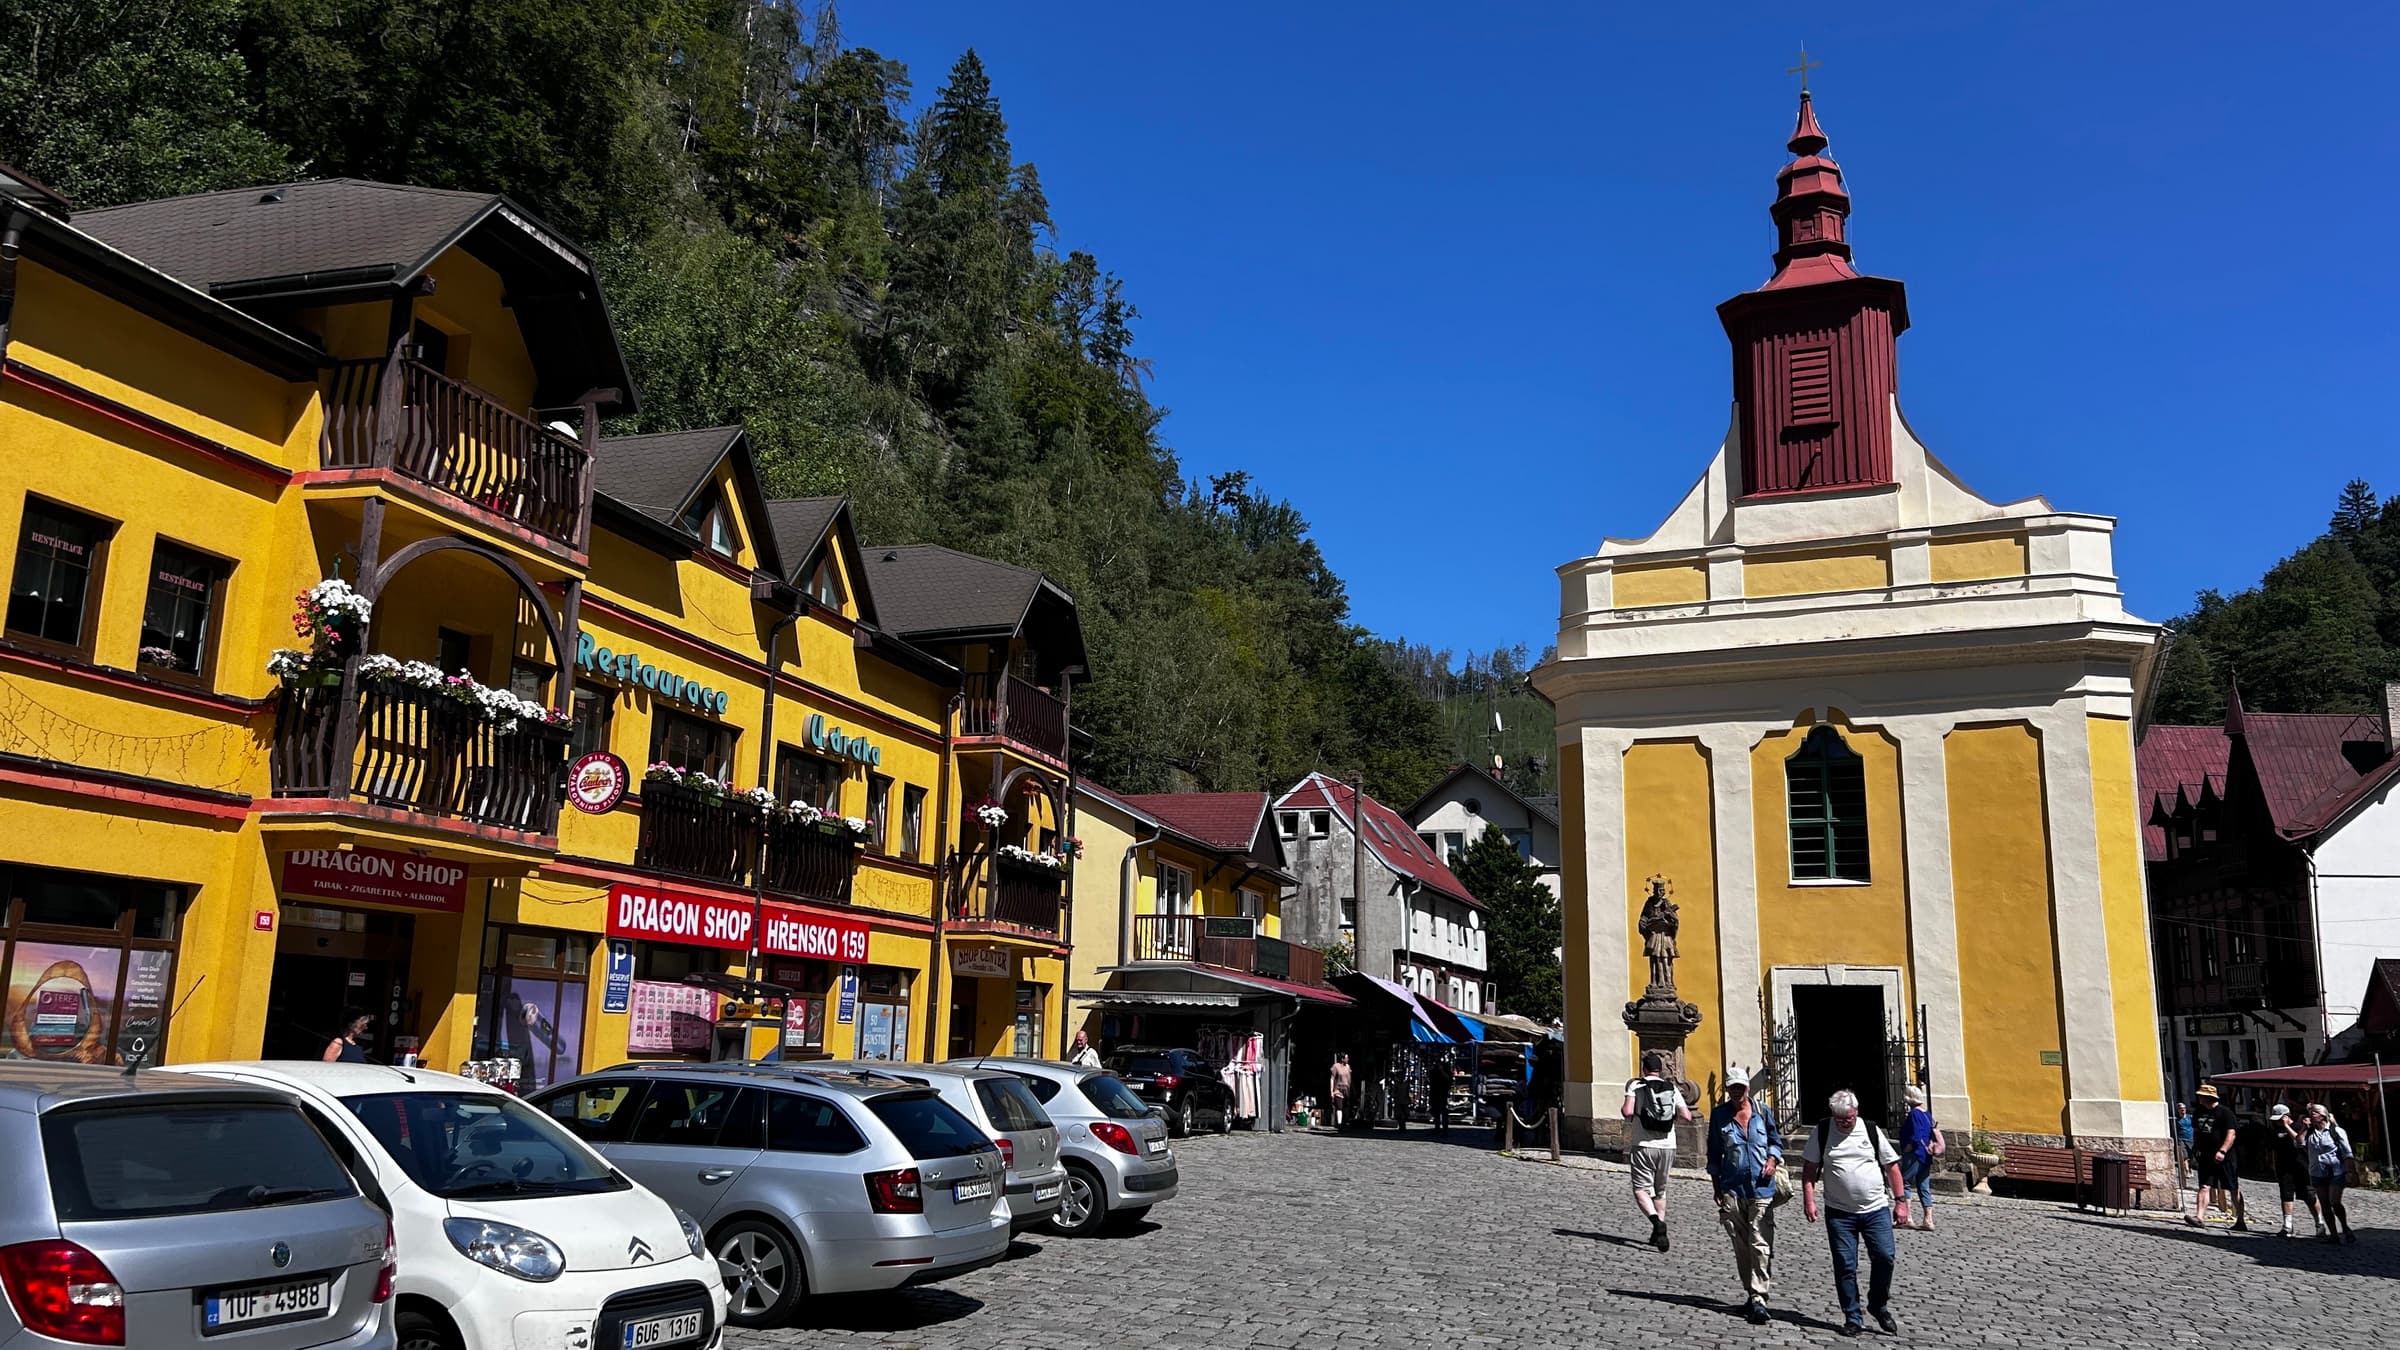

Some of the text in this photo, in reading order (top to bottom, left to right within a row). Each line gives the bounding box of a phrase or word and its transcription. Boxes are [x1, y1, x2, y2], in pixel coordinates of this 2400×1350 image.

[577, 631, 728, 714] Restaurace
[588, 754, 611, 763] PIVO
[829, 727, 881, 766] draka
[291, 848, 464, 886] DRAGON SHOP
[313, 879, 448, 904] TABAK ZIGARETTEN ALKOHOL
[618, 893, 752, 942] DRAGON SHOP
[766, 913, 866, 960] HŘENSKO 159
[614, 943, 627, 970] P
[958, 948, 978, 966] SHOP
[979, 948, 1007, 972] CENTER
[845, 967, 854, 990] P
[225, 1282, 320, 1320] 1UF 4988
[207, 1313, 218, 1322] CZ
[636, 1315, 697, 1345] 6U6 1316
